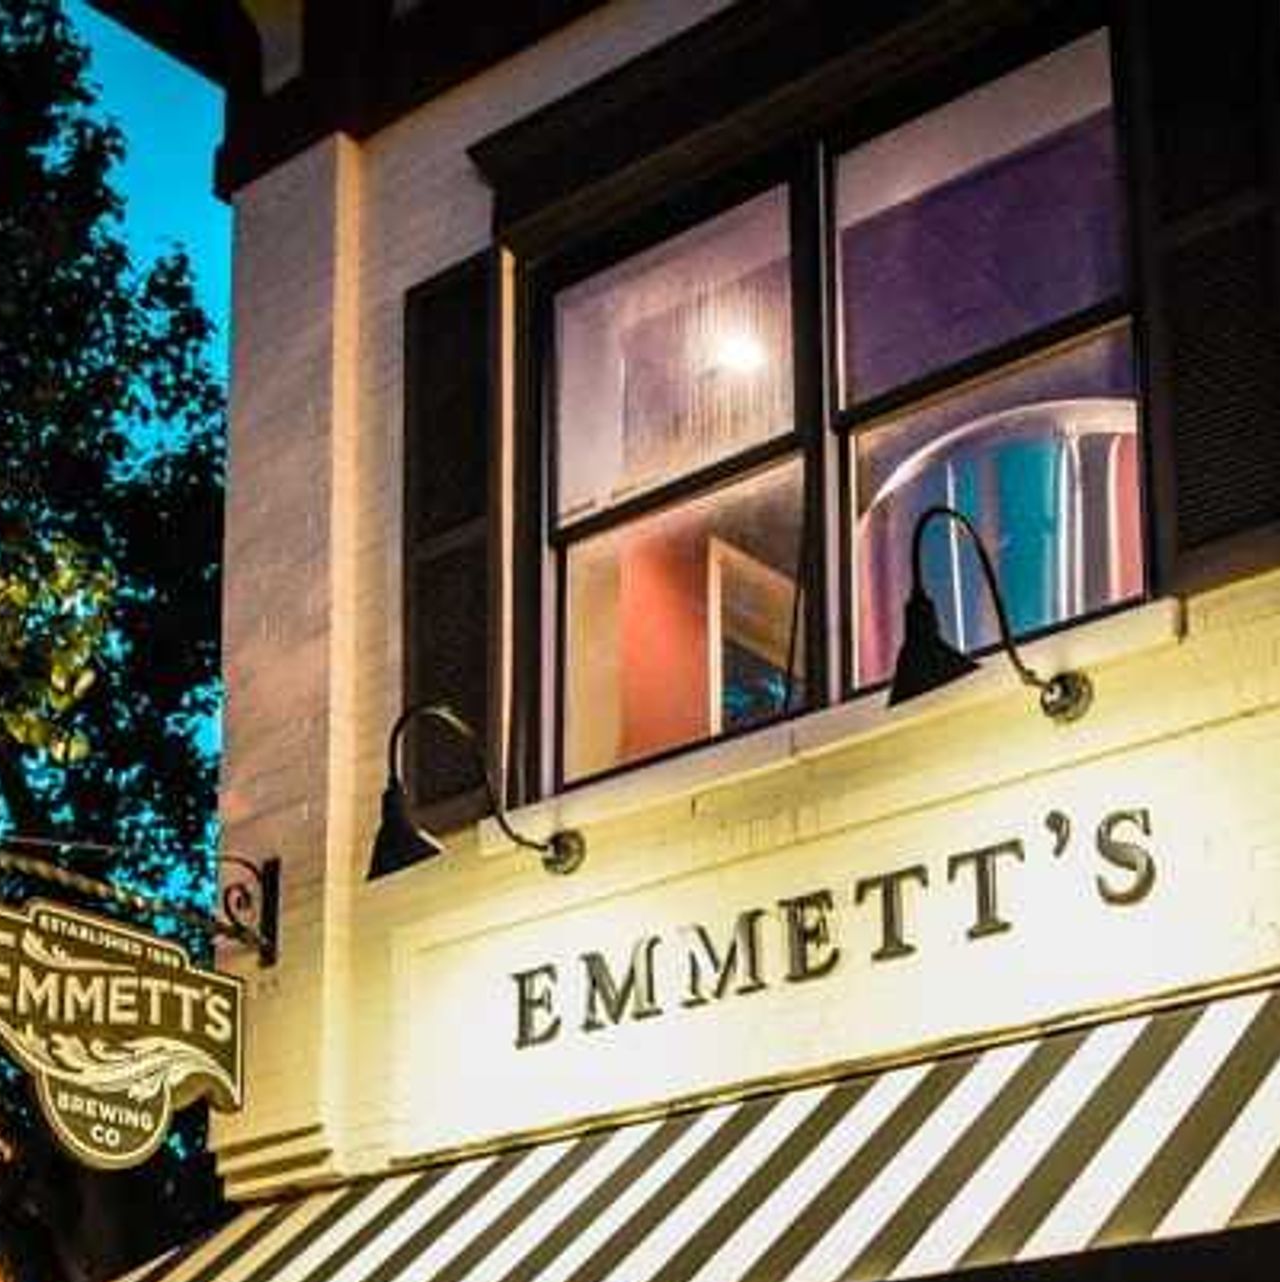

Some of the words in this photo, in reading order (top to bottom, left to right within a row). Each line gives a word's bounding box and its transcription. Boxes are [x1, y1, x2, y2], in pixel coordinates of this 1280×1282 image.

[510, 807, 1158, 1050] EMMETT'S
[56, 1092, 154, 1132] BREWING
[90, 1124, 121, 1147] CO
